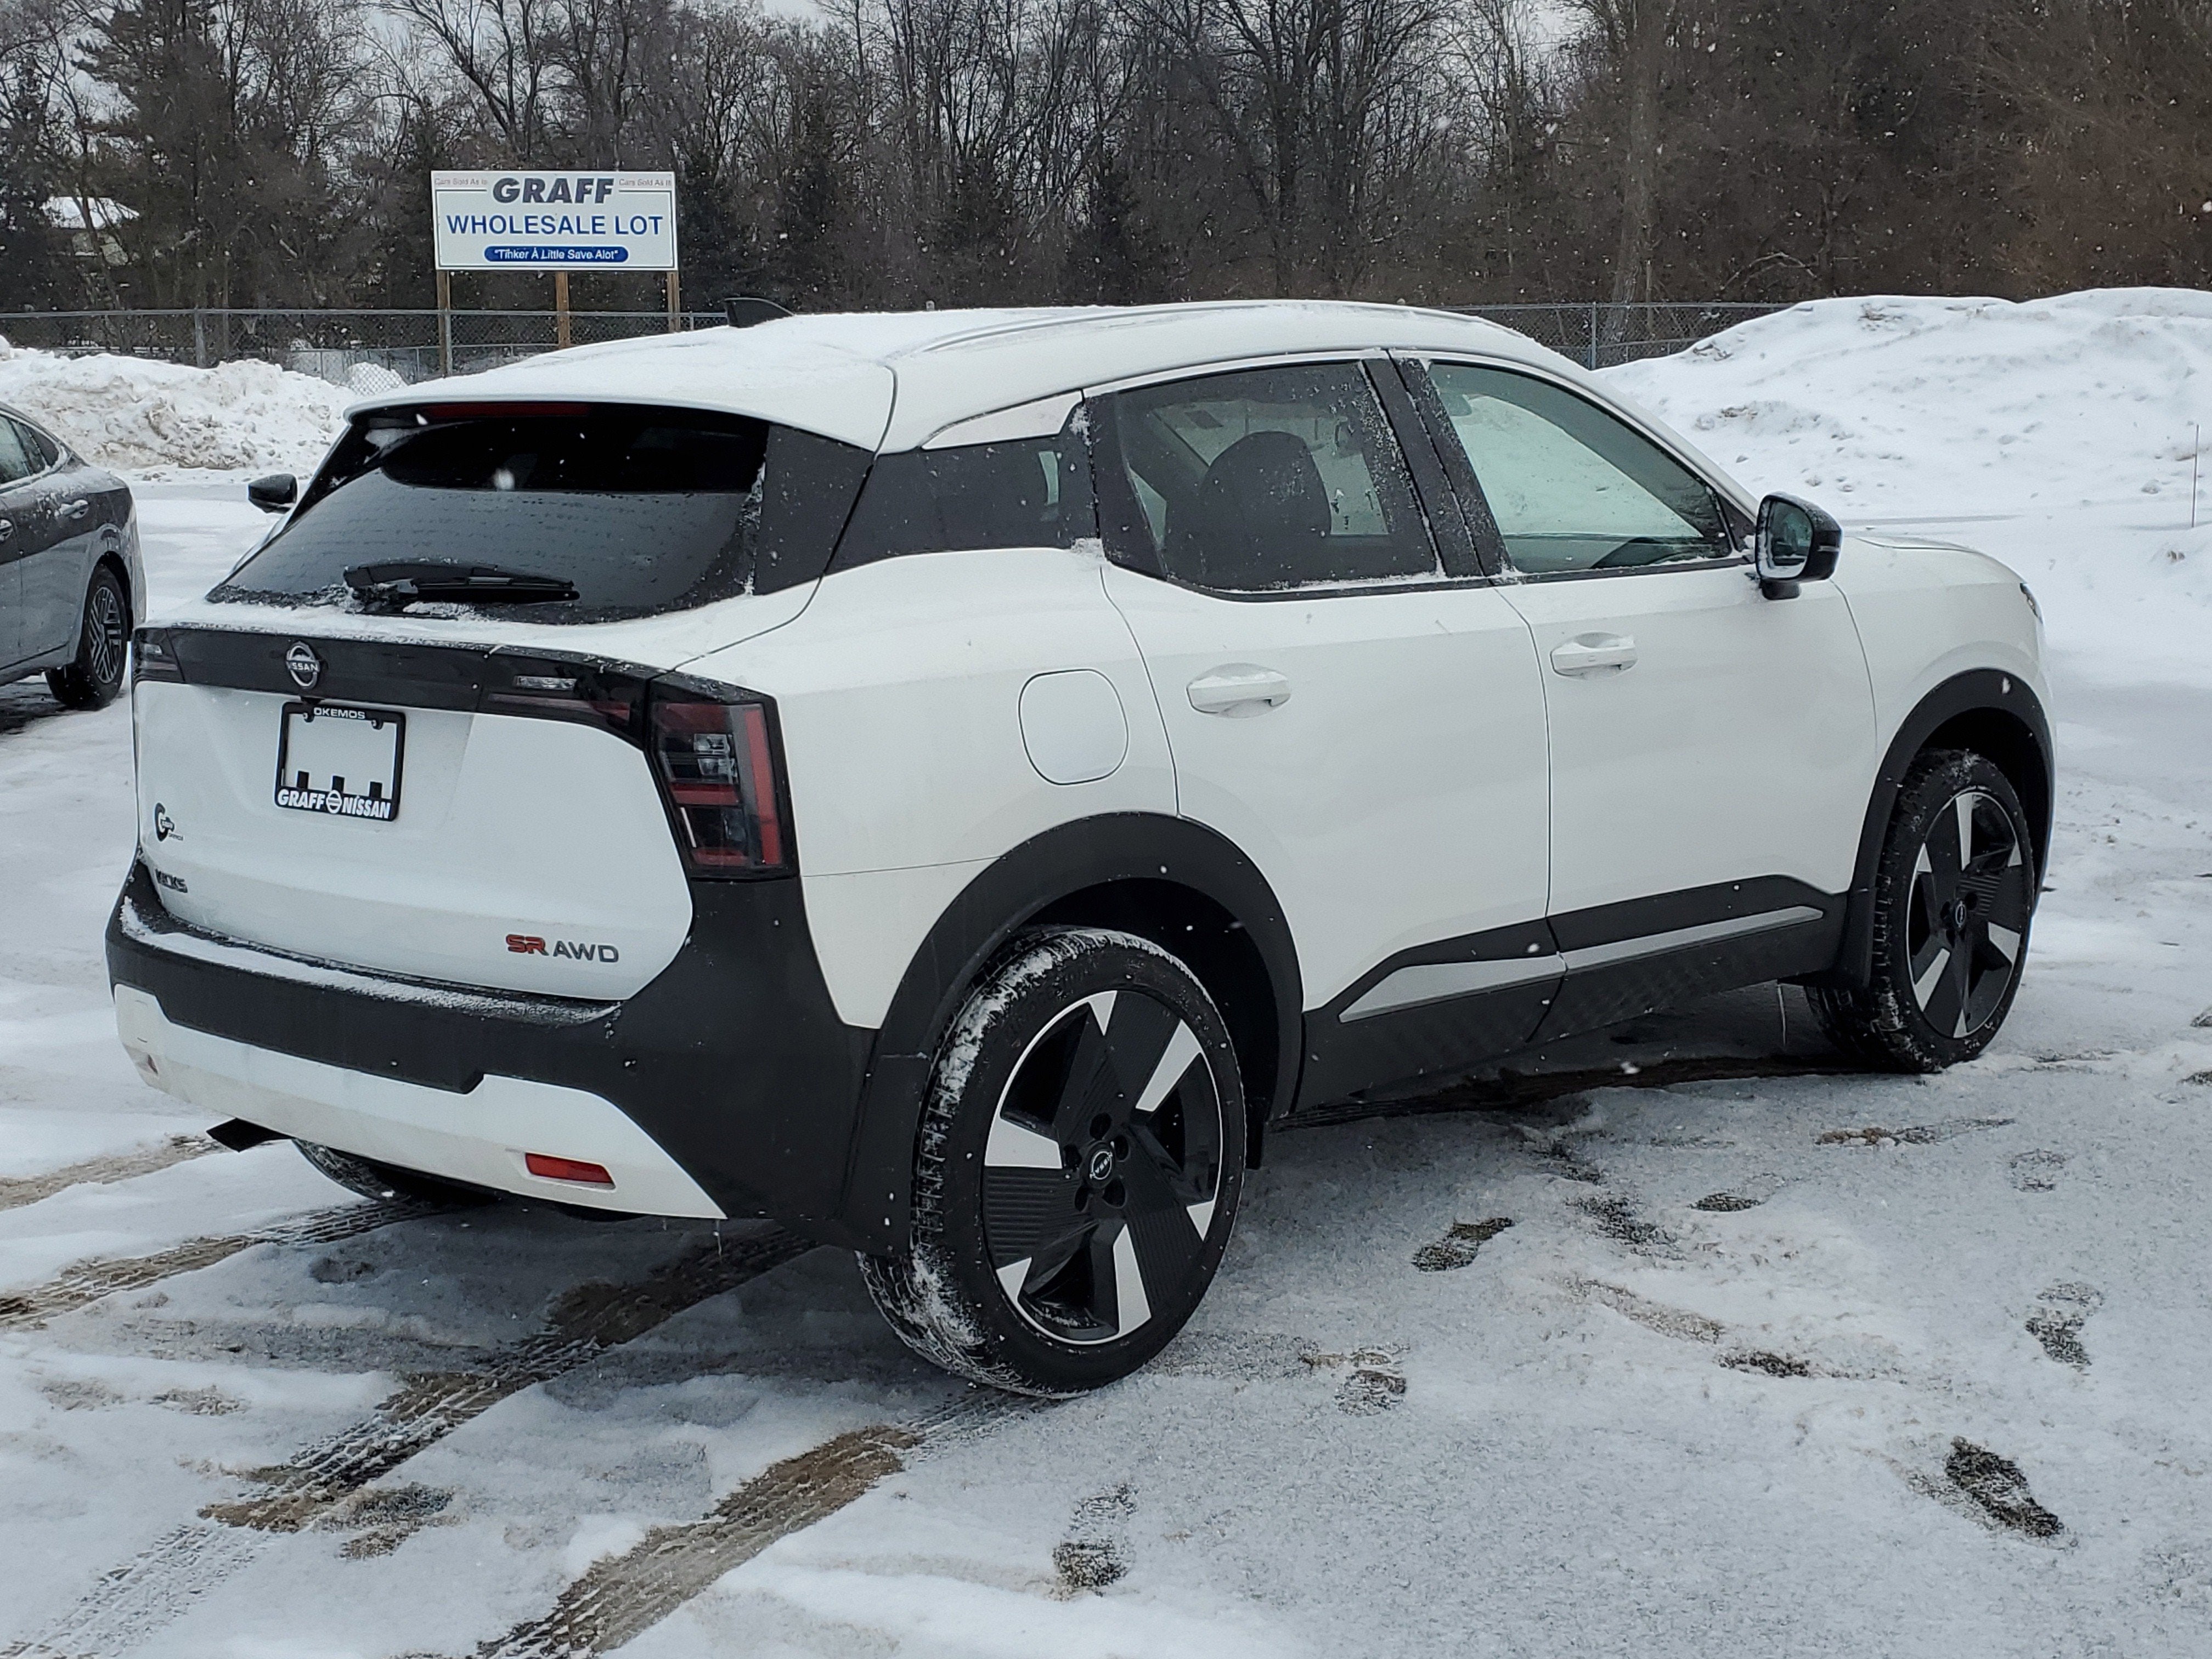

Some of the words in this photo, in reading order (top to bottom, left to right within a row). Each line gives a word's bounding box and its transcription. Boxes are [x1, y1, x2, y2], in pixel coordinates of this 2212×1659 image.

[493, 177, 614, 204] GRAFF
[446, 215, 606, 235] WHOLESALE
[615, 215, 663, 235] LOT
[531, 249, 539, 259] A
[540, 249, 565, 259] Little
[567, 249, 594, 259] Save
[286, 661, 319, 672] SSAN
[313, 707, 366, 720] OKEMOS
[277, 789, 326, 810] GRAFF
[341, 795, 392, 819] NISSAN
[506, 934, 549, 956] SR
[552, 940, 619, 963] AWD
